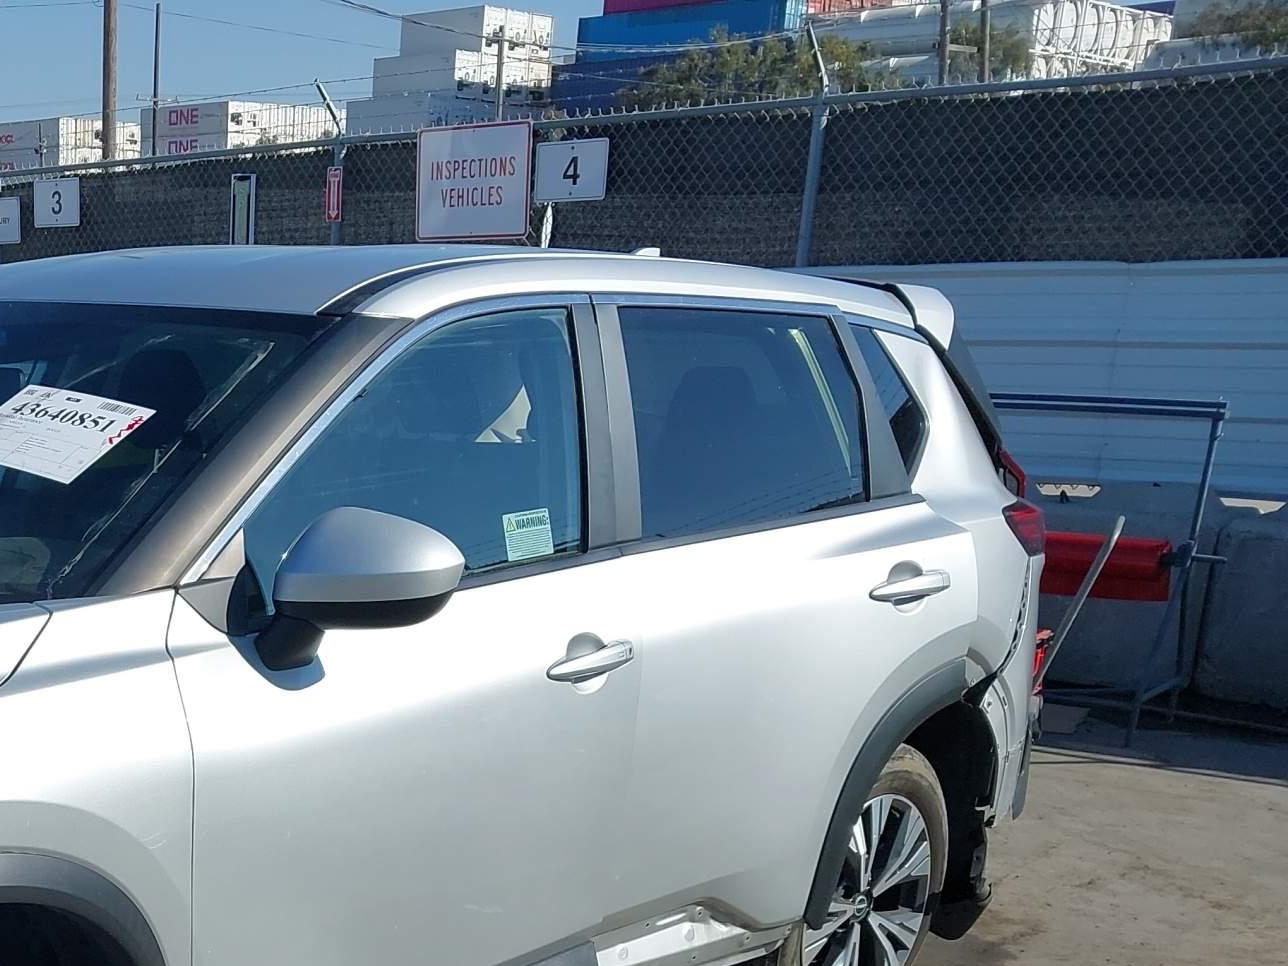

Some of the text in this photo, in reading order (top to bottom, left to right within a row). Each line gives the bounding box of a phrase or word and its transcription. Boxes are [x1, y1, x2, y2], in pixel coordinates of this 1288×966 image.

[168, 107, 199, 127] ONE
[430, 156, 516, 181] INSPECTIONS
[562, 156, 581, 186] 4
[52, 190, 62, 215] 3
[440, 186, 504, 208] VEHICLES
[11, 401, 117, 432] 43640851
[515, 515, 549, 529] WARNING:
